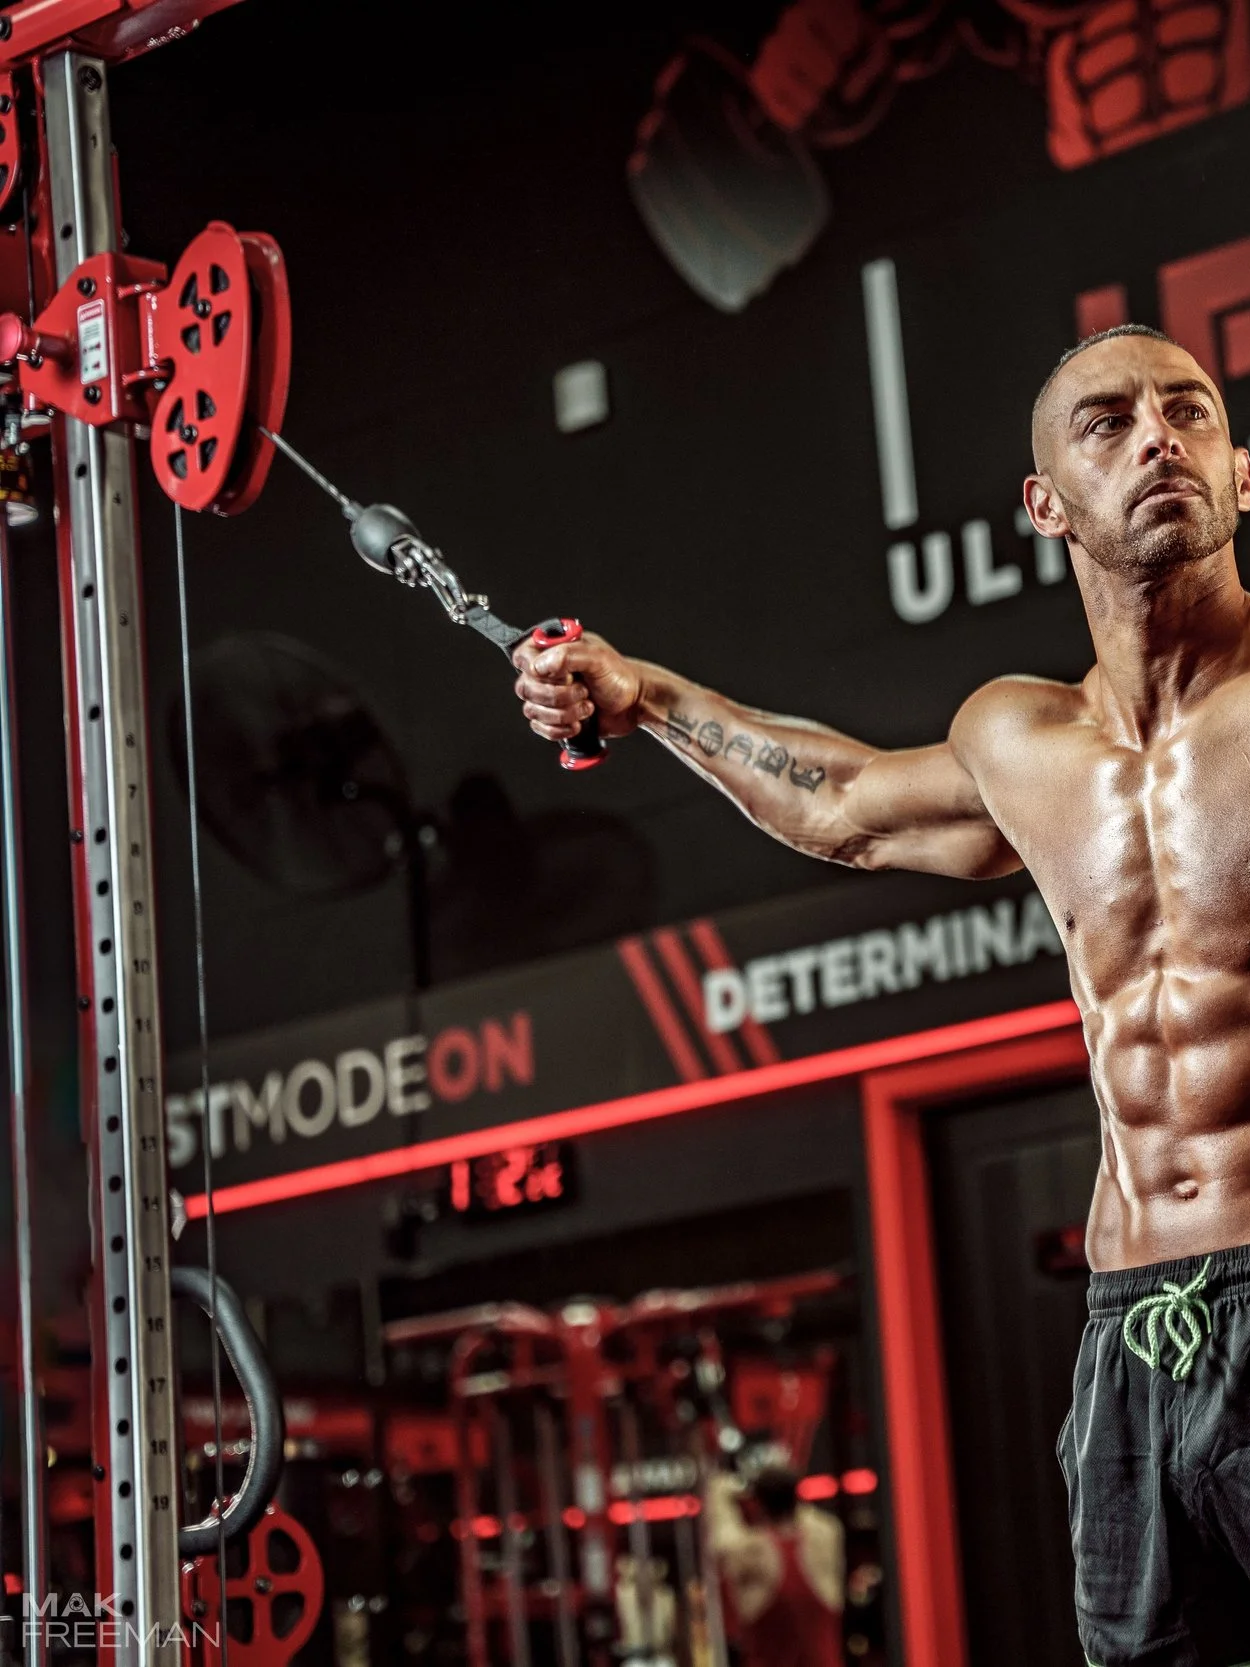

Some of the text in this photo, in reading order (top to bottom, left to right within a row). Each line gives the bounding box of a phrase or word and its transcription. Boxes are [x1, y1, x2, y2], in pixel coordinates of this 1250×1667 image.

[147, 1317, 164, 1332] 16
[148, 1377, 165, 1394] 17
[152, 1495, 169, 1511] 19
